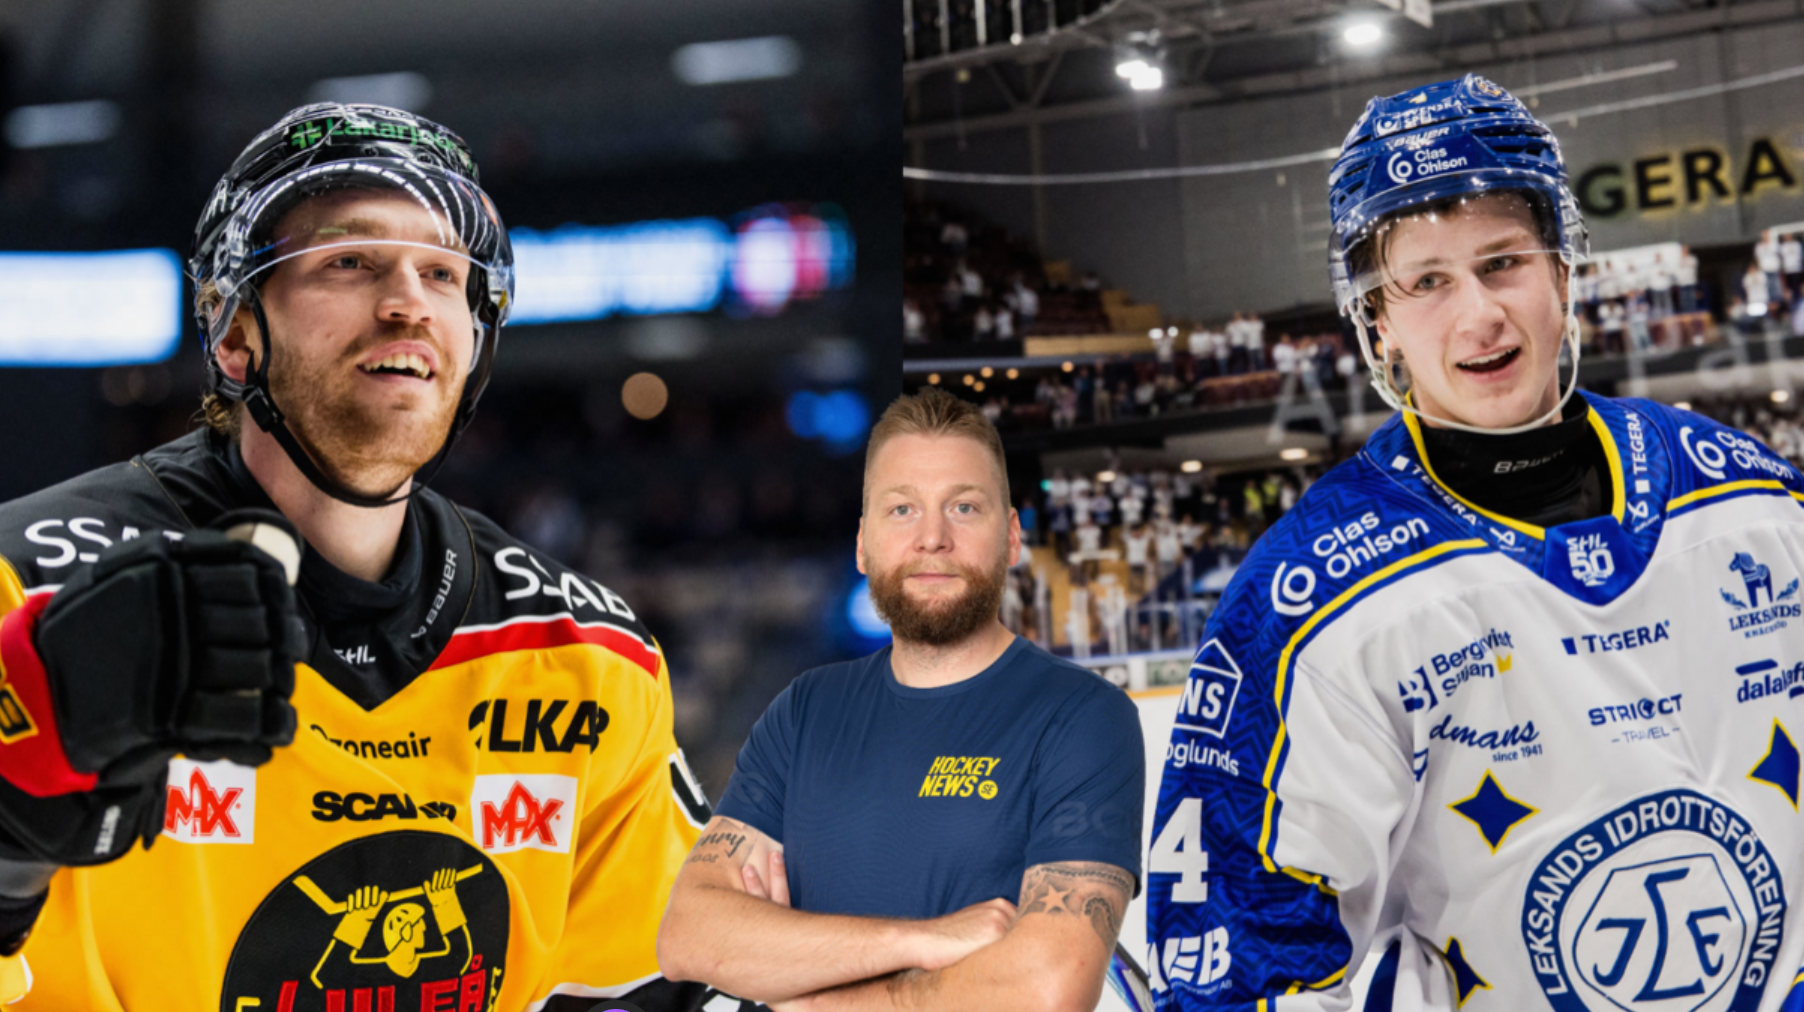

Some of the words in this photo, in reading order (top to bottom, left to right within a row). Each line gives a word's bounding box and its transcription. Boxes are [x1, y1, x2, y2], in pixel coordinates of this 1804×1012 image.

[1414, 147, 1448, 163] Clas
[1417, 156, 1468, 175] Ohlson
[1576, 138, 1795, 220] GERA
[1625, 413, 1648, 476] TEGERA
[1312, 511, 1380, 557] Clas
[1325, 517, 1430, 579] Ohlson
[1569, 549, 1615, 580] 50
[928, 755, 1001, 776] HOCKEY
[1492, 751, 1518, 763] since
[1520, 744, 1543, 759] 1941
[918, 774, 979, 797] NEWS
[480, 780, 565, 849] MAX
[1527, 834, 1603, 996] LEKSANDS
[1603, 796, 1782, 988] IDROTTSFÖRENING
